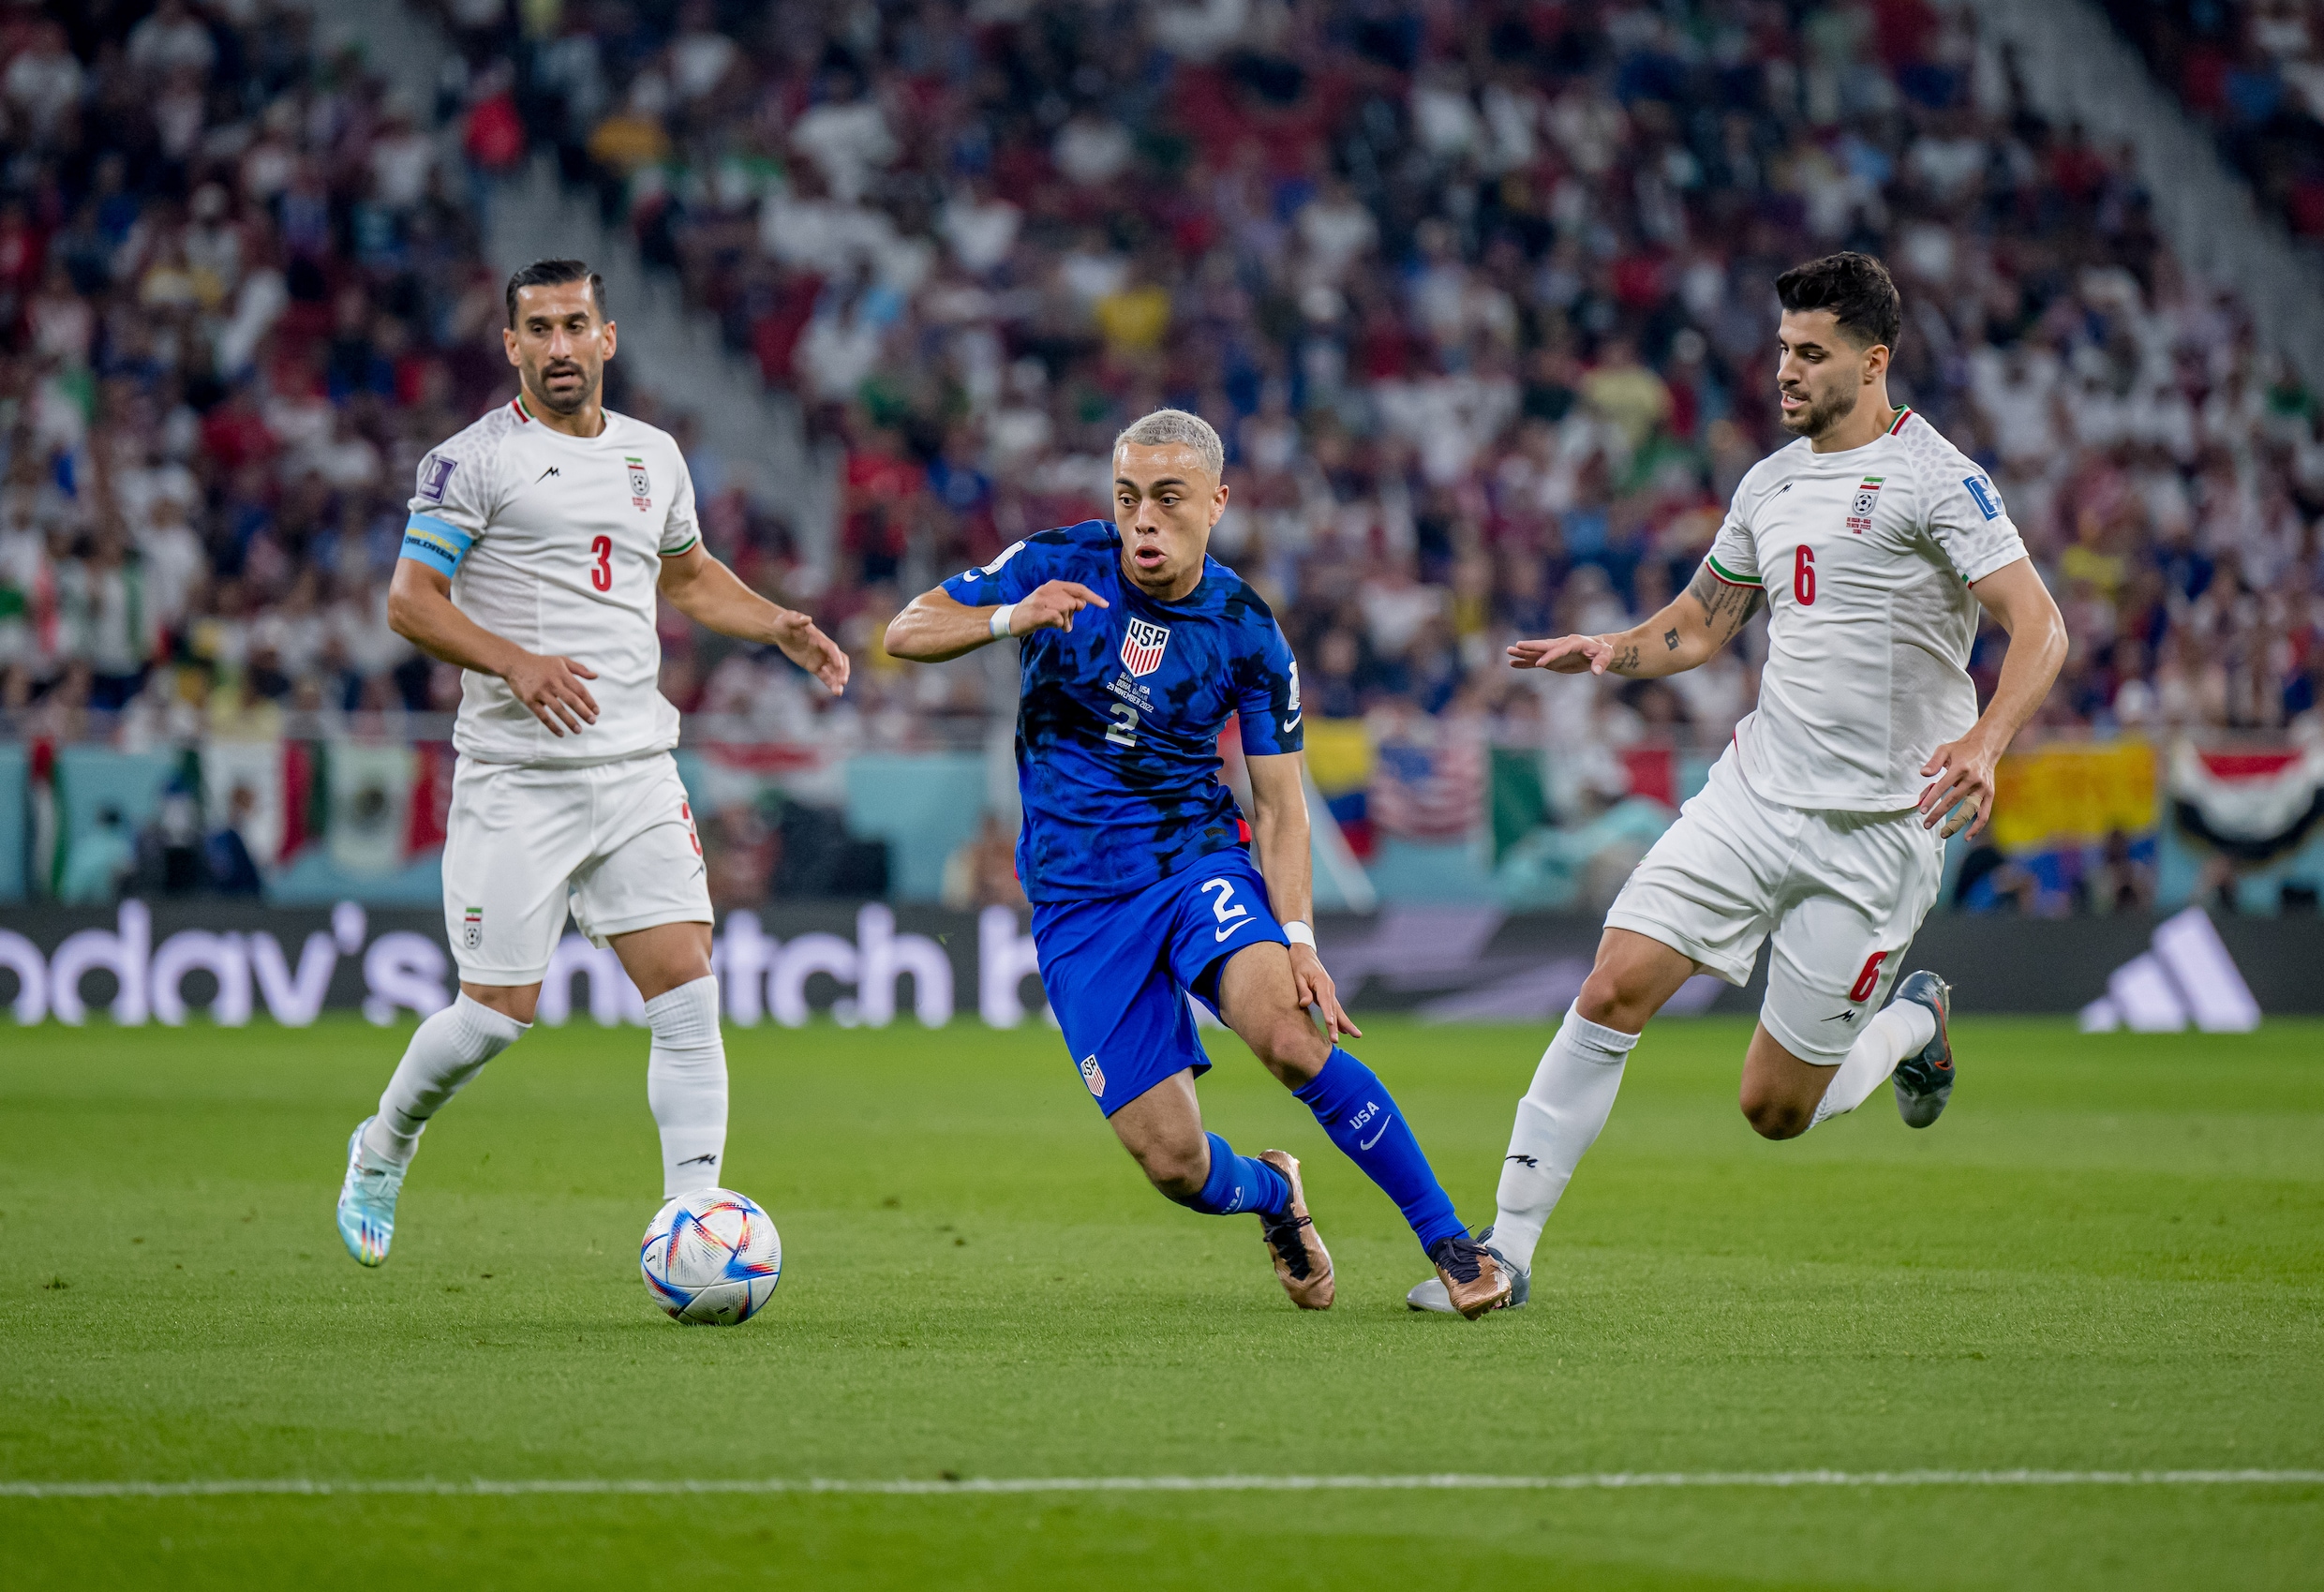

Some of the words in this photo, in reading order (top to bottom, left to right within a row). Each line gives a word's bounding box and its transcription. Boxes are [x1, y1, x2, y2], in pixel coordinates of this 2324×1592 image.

[405, 536, 456, 564] CHILDREN
[591, 535, 612, 592] 3
[1794, 544, 1816, 606] 6
[1130, 620, 1167, 647] USA
[1106, 681, 1115, 692] 29
[1114, 685, 1141, 706] NOVEMBER
[1139, 700, 1155, 713] 2022
[1120, 671, 1132, 683] IRAN
[1139, 684, 1151, 695] USA
[1105, 703, 1140, 747] 2
[1200, 877, 1247, 924] 2
[538, 901, 955, 1028] mtch
[1849, 951, 1888, 1004] 6
[1081, 1057, 1096, 1076] USA
[1349, 1101, 1380, 1130] USA
